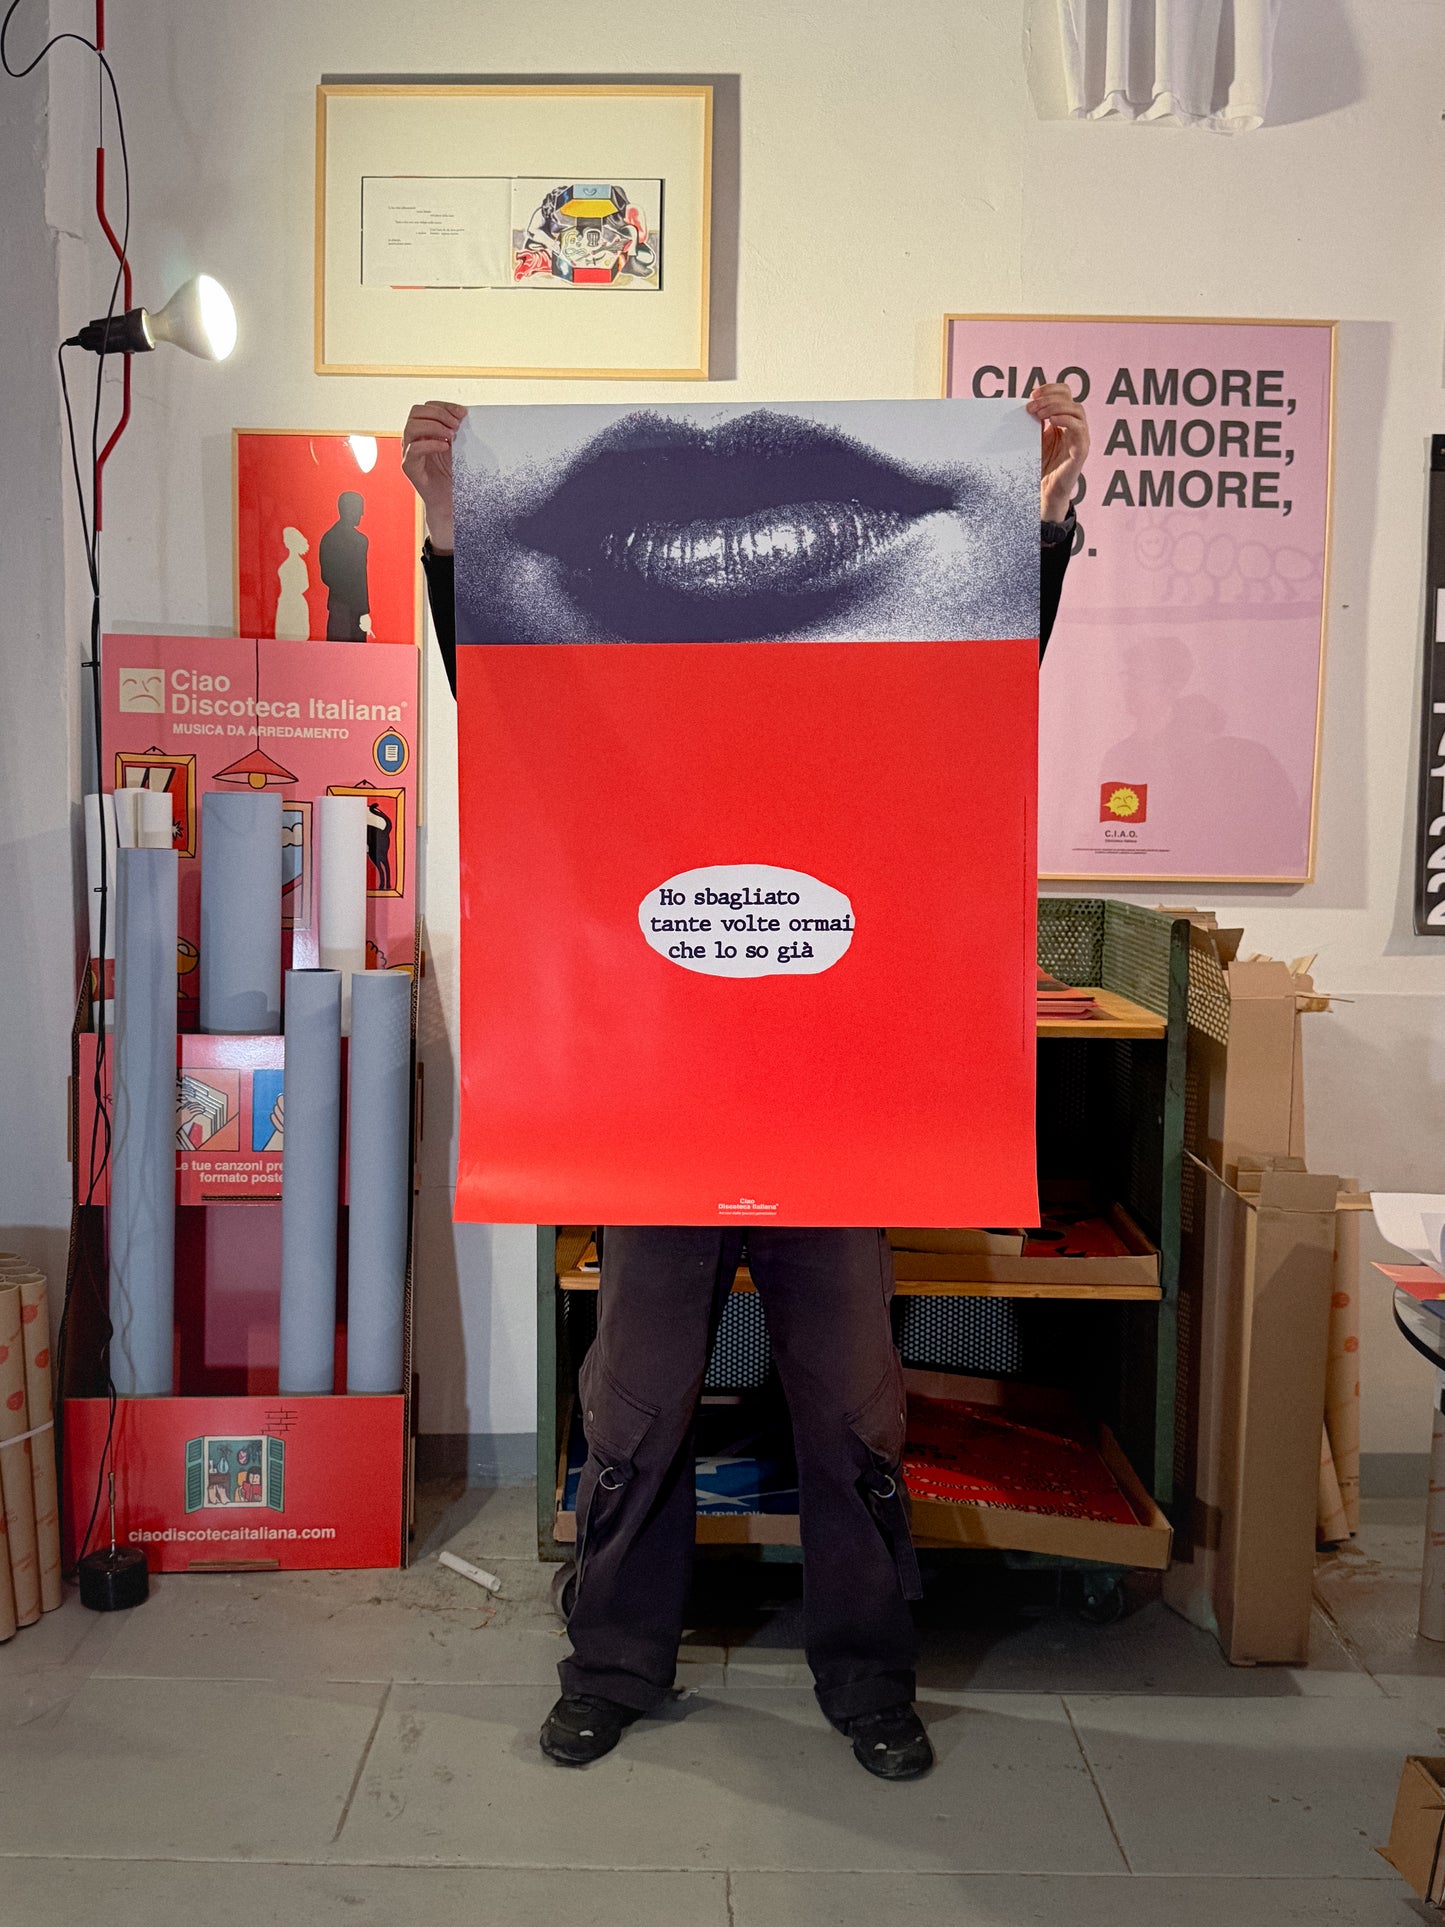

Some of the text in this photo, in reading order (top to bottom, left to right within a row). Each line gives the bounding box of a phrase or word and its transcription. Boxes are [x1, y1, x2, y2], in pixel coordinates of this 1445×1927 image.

[972, 365, 1297, 415] CIAO AMORE,
[1103, 419, 1295, 466] AMORE,
[1101, 469, 1293, 516] AMORE,
[171, 669, 231, 692] Ciao
[171, 693, 300, 718] Discoteca
[172, 723, 350, 739] MUSICA DA ARREDAMENTO
[1104, 830, 1138, 838] C.I.A.O.
[659, 888, 800, 910] Ho sbagliato
[650, 914, 855, 932] tante volte ormai
[668, 941, 814, 963] che lo so già
[176, 1162, 188, 1171] e
[191, 1160, 212, 1171] tue
[214, 1160, 263, 1171] canzoni
[199, 1172, 248, 1183] formato
[128, 1527, 336, 1543] ciaodiscotecaitaliana.com
